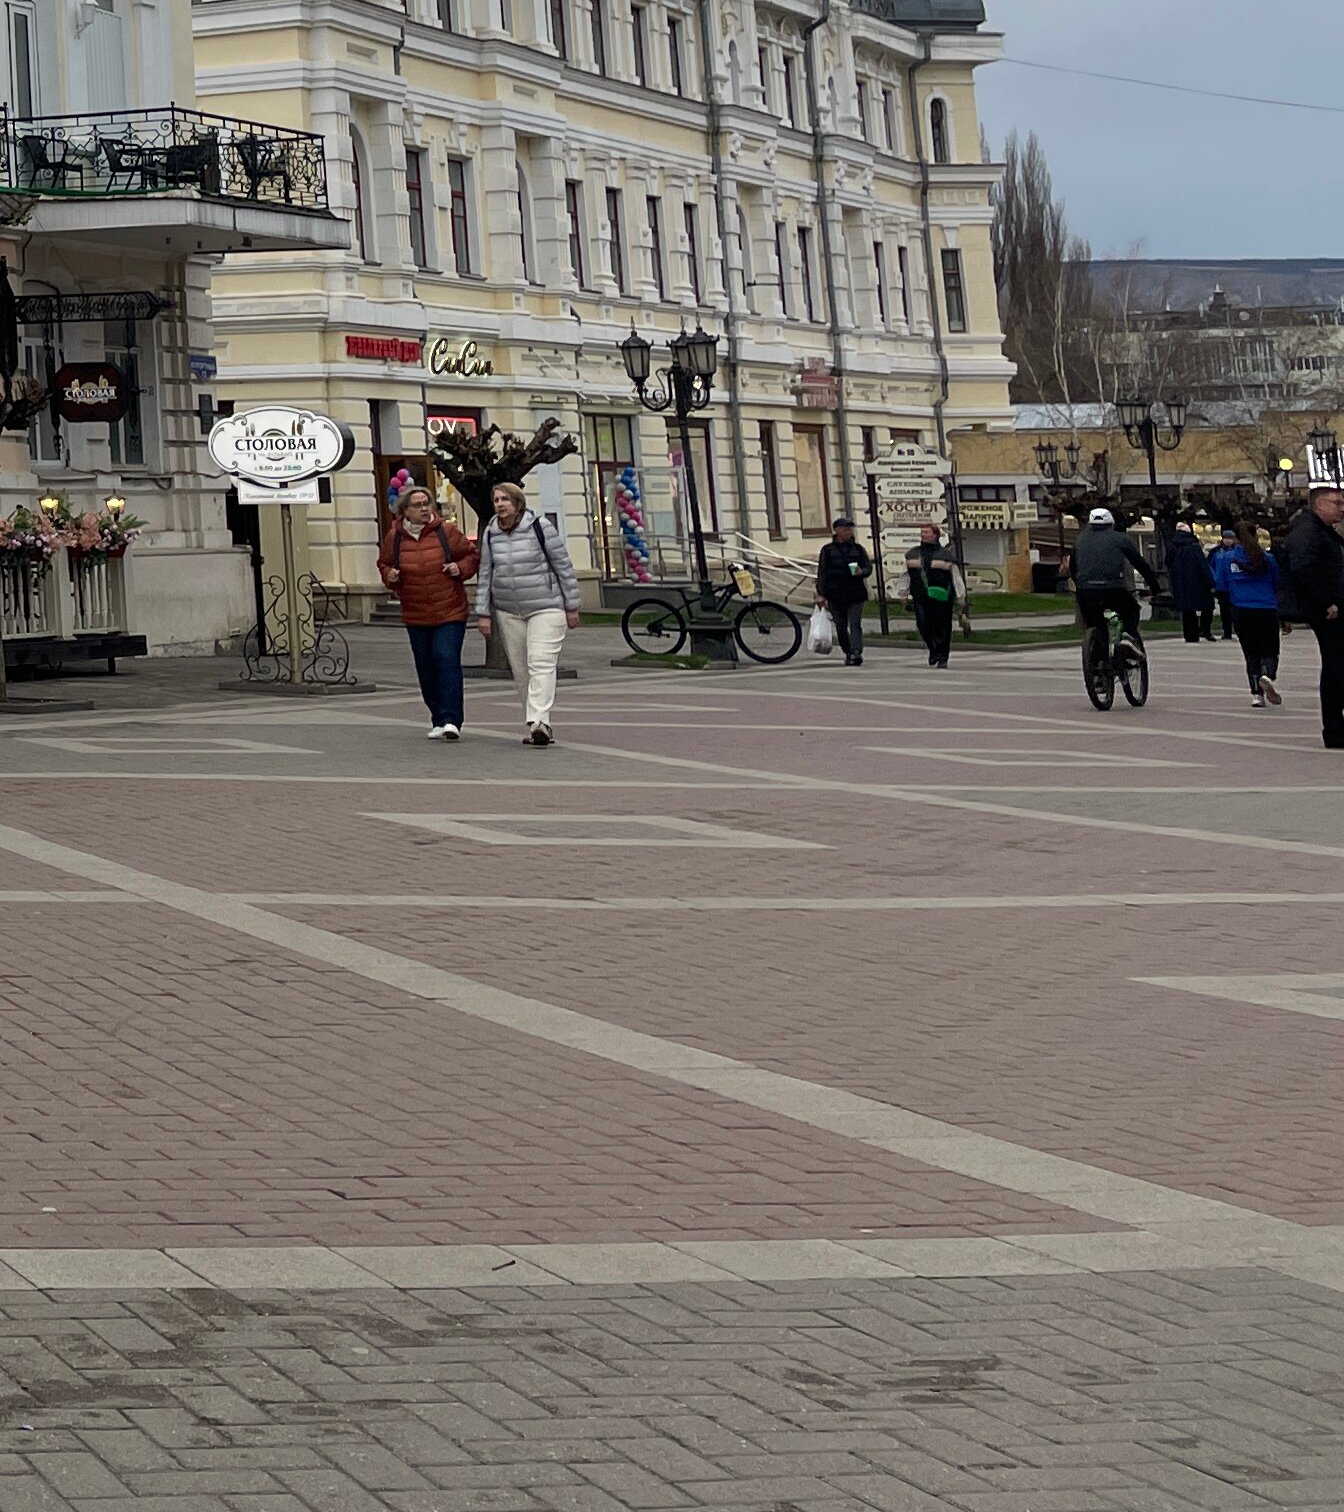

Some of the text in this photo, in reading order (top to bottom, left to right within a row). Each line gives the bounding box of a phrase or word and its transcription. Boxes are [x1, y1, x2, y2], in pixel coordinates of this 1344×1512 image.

[64, 388, 116, 398] СТОЛОВАЯ
[235, 438, 317, 452] СТОЛОВАЯ
[885, 501, 938, 513] ХОСТЕЛ
